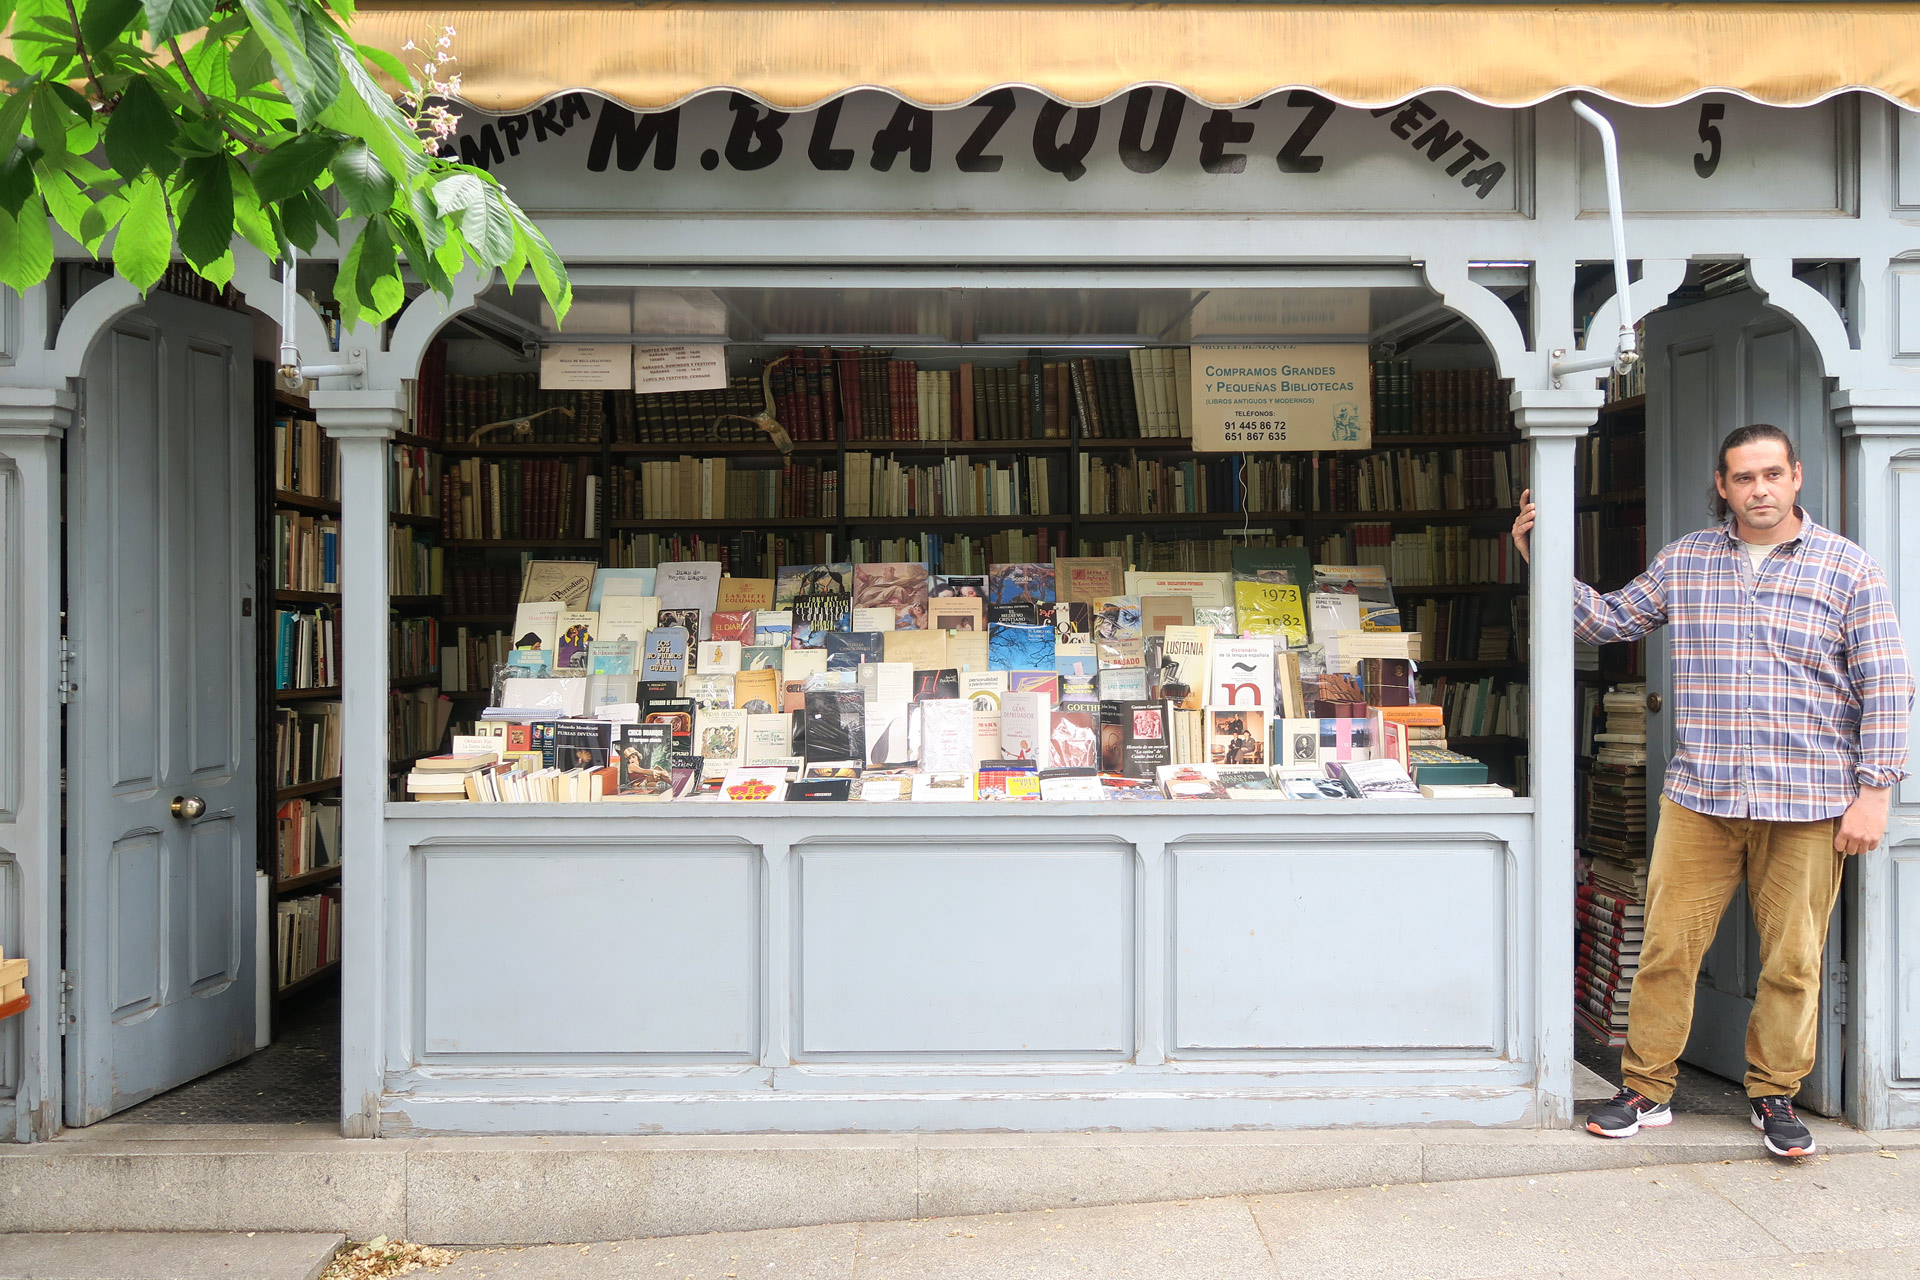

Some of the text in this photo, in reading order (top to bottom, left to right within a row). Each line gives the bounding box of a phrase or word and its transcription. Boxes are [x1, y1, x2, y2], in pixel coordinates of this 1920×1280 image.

[438, 93, 591, 172] MPRA
[1694, 104, 1725, 179] 5
[1224, 422, 1286, 430] 91 445 86 72
[1225, 432, 1286, 441] 651 867 635
[1262, 589, 1297, 602] 1973
[1265, 614, 1301, 626] 1982
[1166, 641, 1203, 656] LUSITANIA
